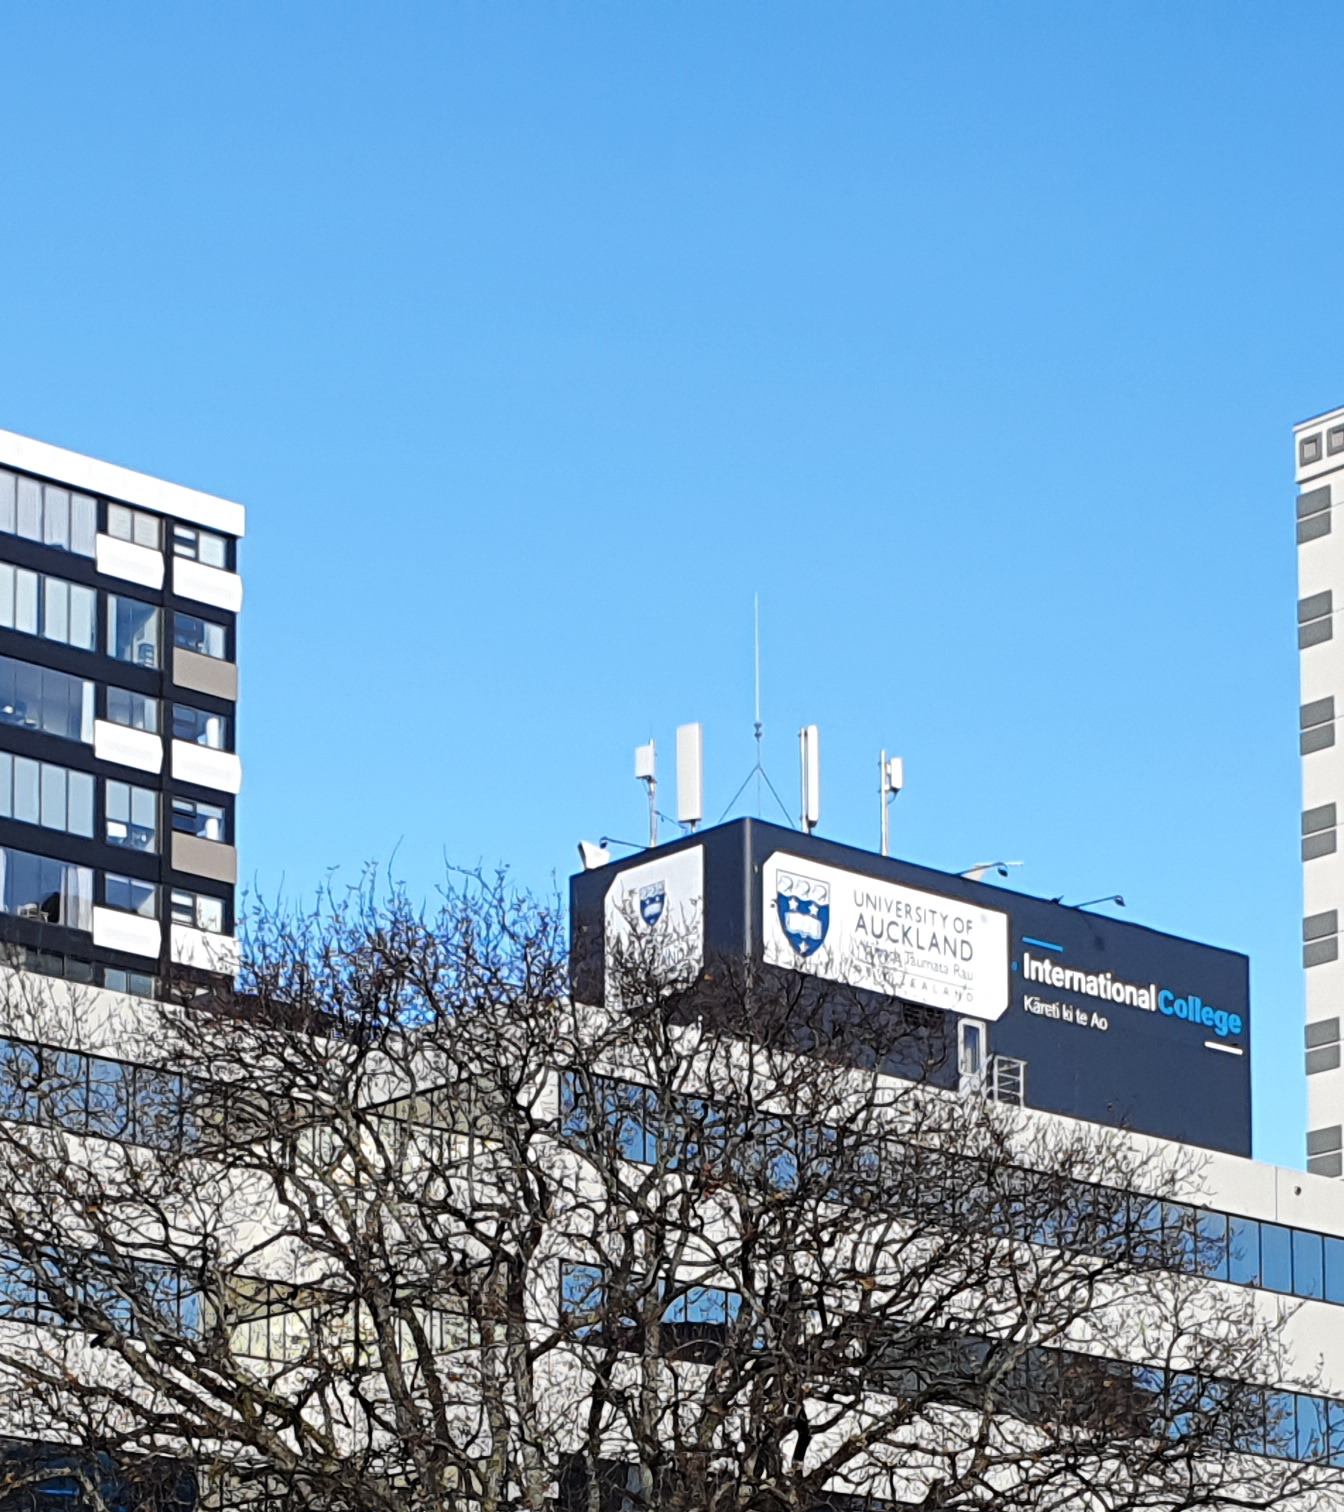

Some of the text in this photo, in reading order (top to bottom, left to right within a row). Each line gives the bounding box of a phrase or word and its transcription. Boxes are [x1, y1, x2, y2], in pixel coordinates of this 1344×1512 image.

[854, 889, 973, 935] UNIVERSITY OF
[855, 912, 974, 962] AUCKLAND
[1023, 952, 1243, 1037] International College
[1075, 1008, 1088, 1026] te
[1090, 1012, 1108, 1030] Ao
